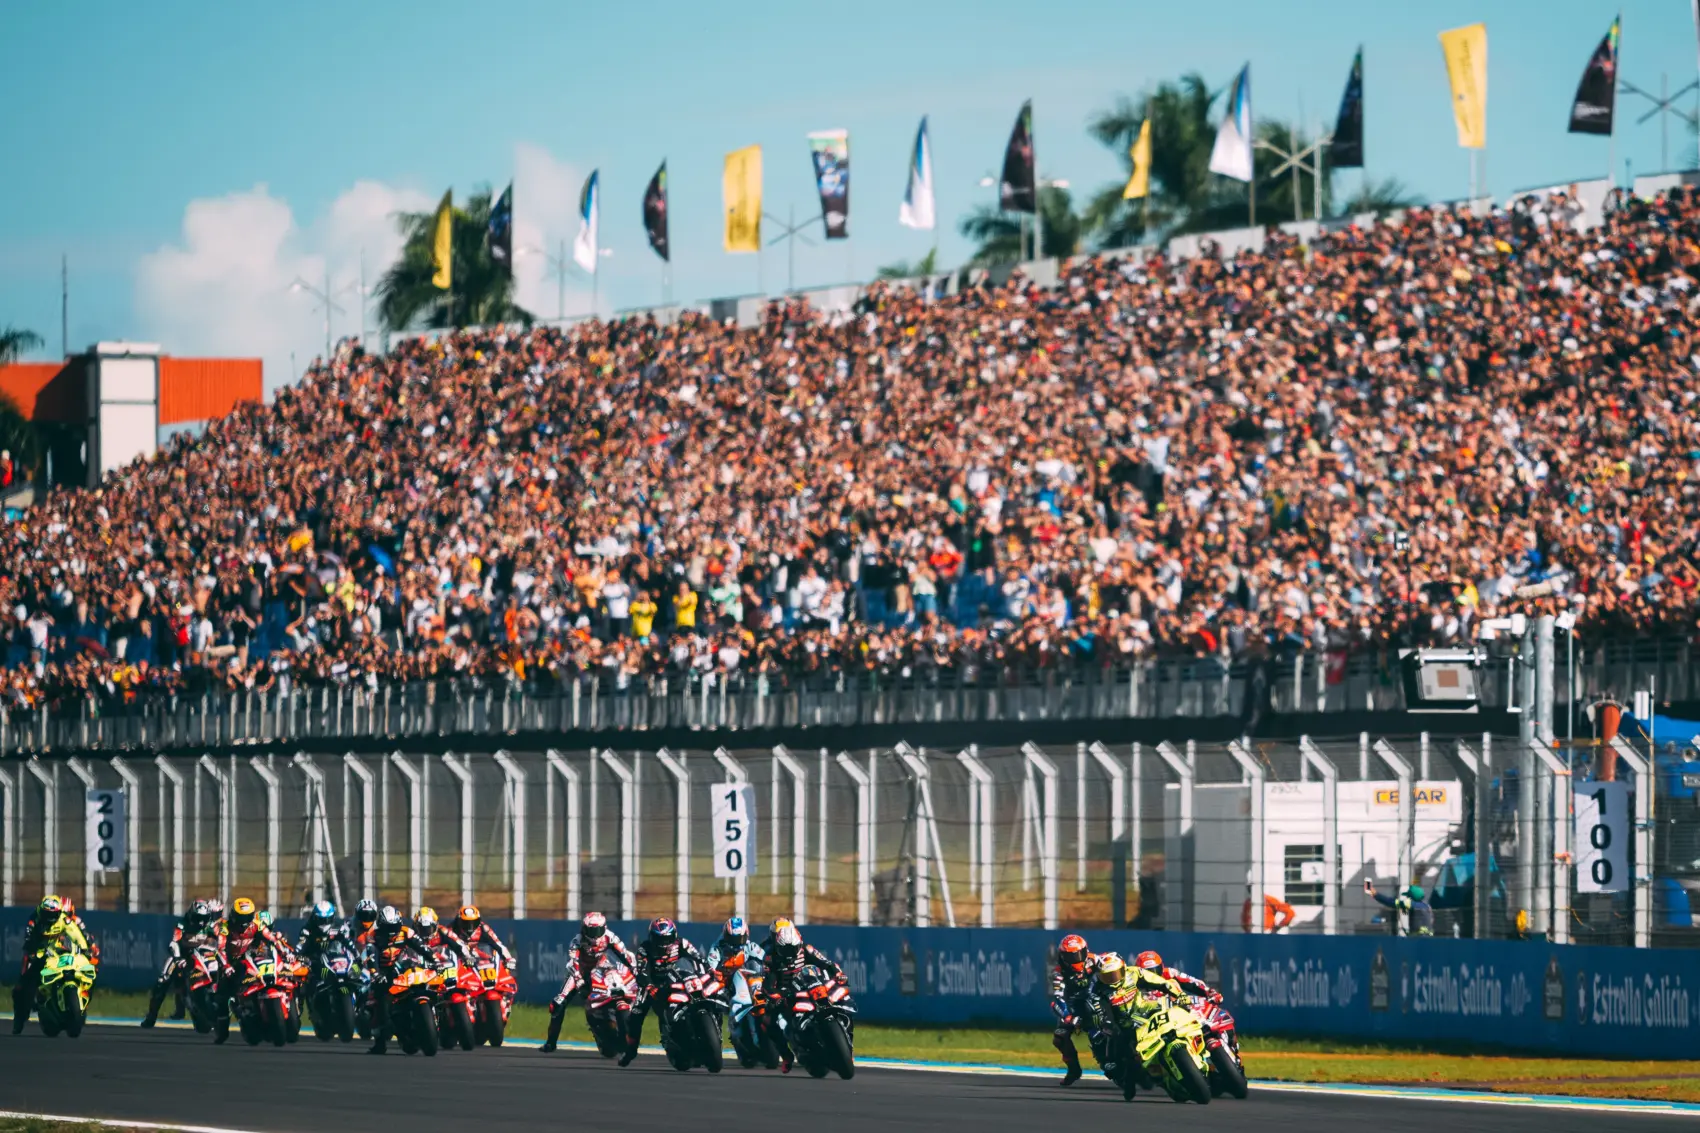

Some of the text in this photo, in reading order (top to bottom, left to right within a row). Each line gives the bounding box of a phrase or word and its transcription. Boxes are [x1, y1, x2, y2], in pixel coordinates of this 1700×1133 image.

[1375, 789, 1444, 804] CEAR
[97, 793, 113, 867] 200
[724, 789, 742, 871] 150
[1591, 788, 1612, 885] 100
[479, 968, 497, 981] 10
[938, 951, 976, 995] Estrella
[977, 949, 1013, 996] Galicia
[1243, 957, 1287, 1007] Estrella
[1288, 957, 1330, 1008] Galicia
[1414, 964, 1458, 1013] Estrella
[1459, 962, 1502, 1016] Galicia
[1147, 1011, 1170, 1033] 49
[1592, 972, 1641, 1026] Estrella
[1643, 972, 1689, 1028] Galicia
